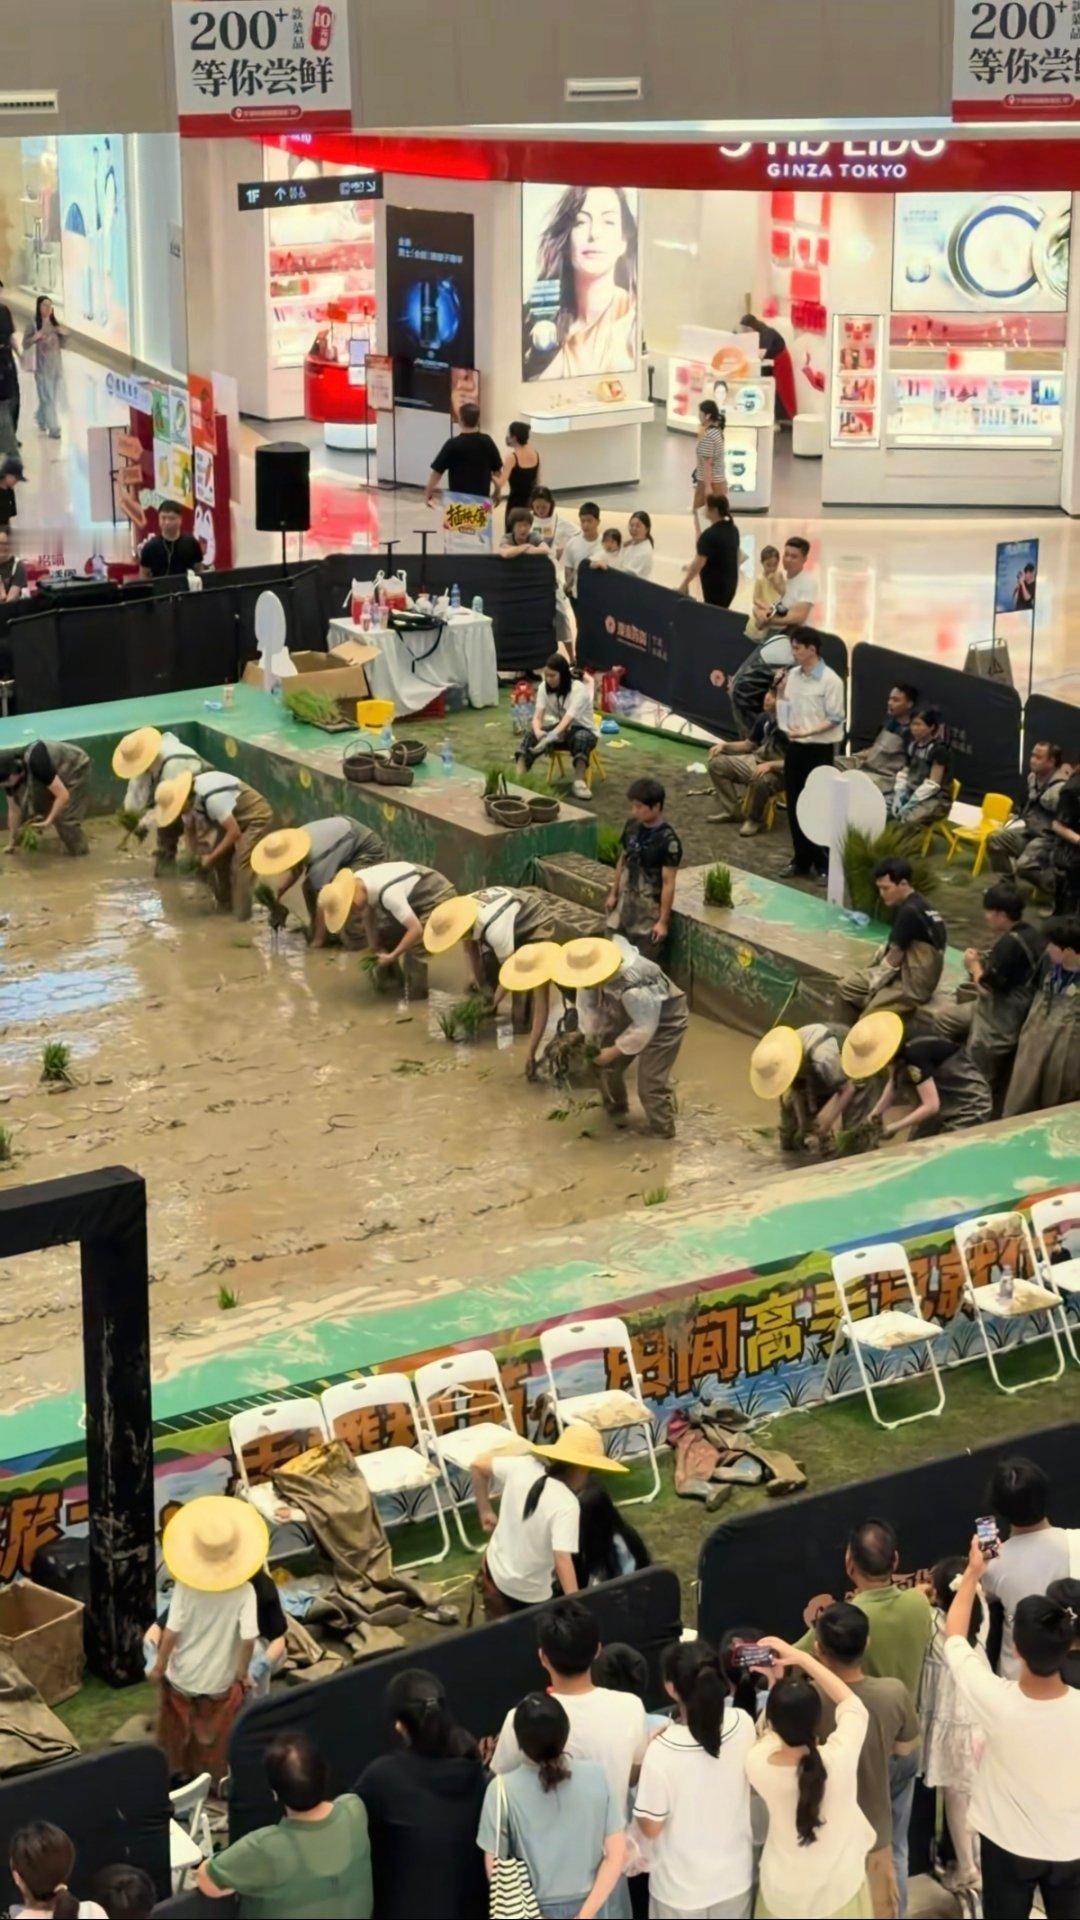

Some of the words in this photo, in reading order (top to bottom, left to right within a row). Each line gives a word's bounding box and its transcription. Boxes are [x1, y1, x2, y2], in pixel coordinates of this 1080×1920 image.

[192, 56, 334, 97] 等你尝鲜
[969, 47, 1080, 84] 等你尝
[767, 163, 832, 178] GINZA
[839, 163, 907, 178] TOKYO
[246, 188, 260, 203] 1F
